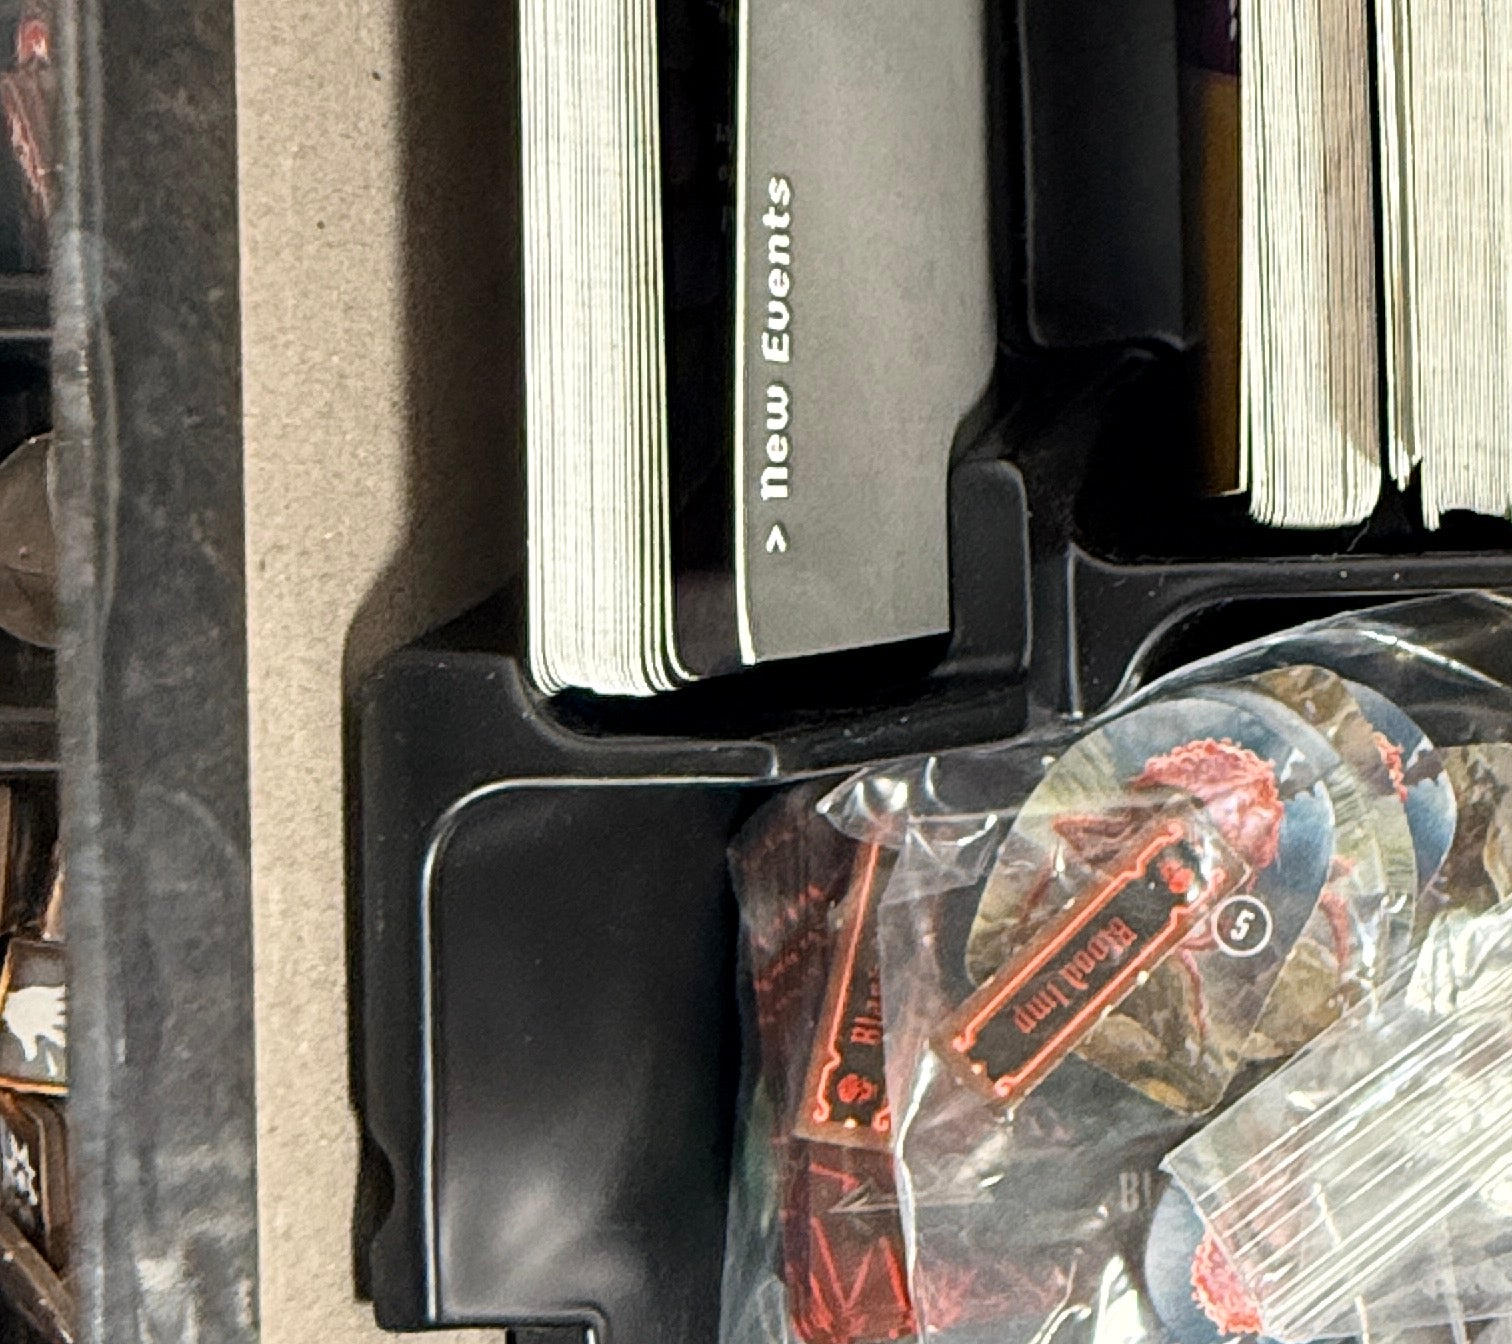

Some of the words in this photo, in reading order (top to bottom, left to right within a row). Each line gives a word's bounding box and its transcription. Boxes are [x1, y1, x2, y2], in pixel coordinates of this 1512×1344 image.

[761, 176, 791, 362] Events
[760, 384, 789, 500] New
[1059, 917, 1139, 990] Blood
[1230, 910, 1256, 941] 5
[1012, 976, 1069, 1034] Imp
